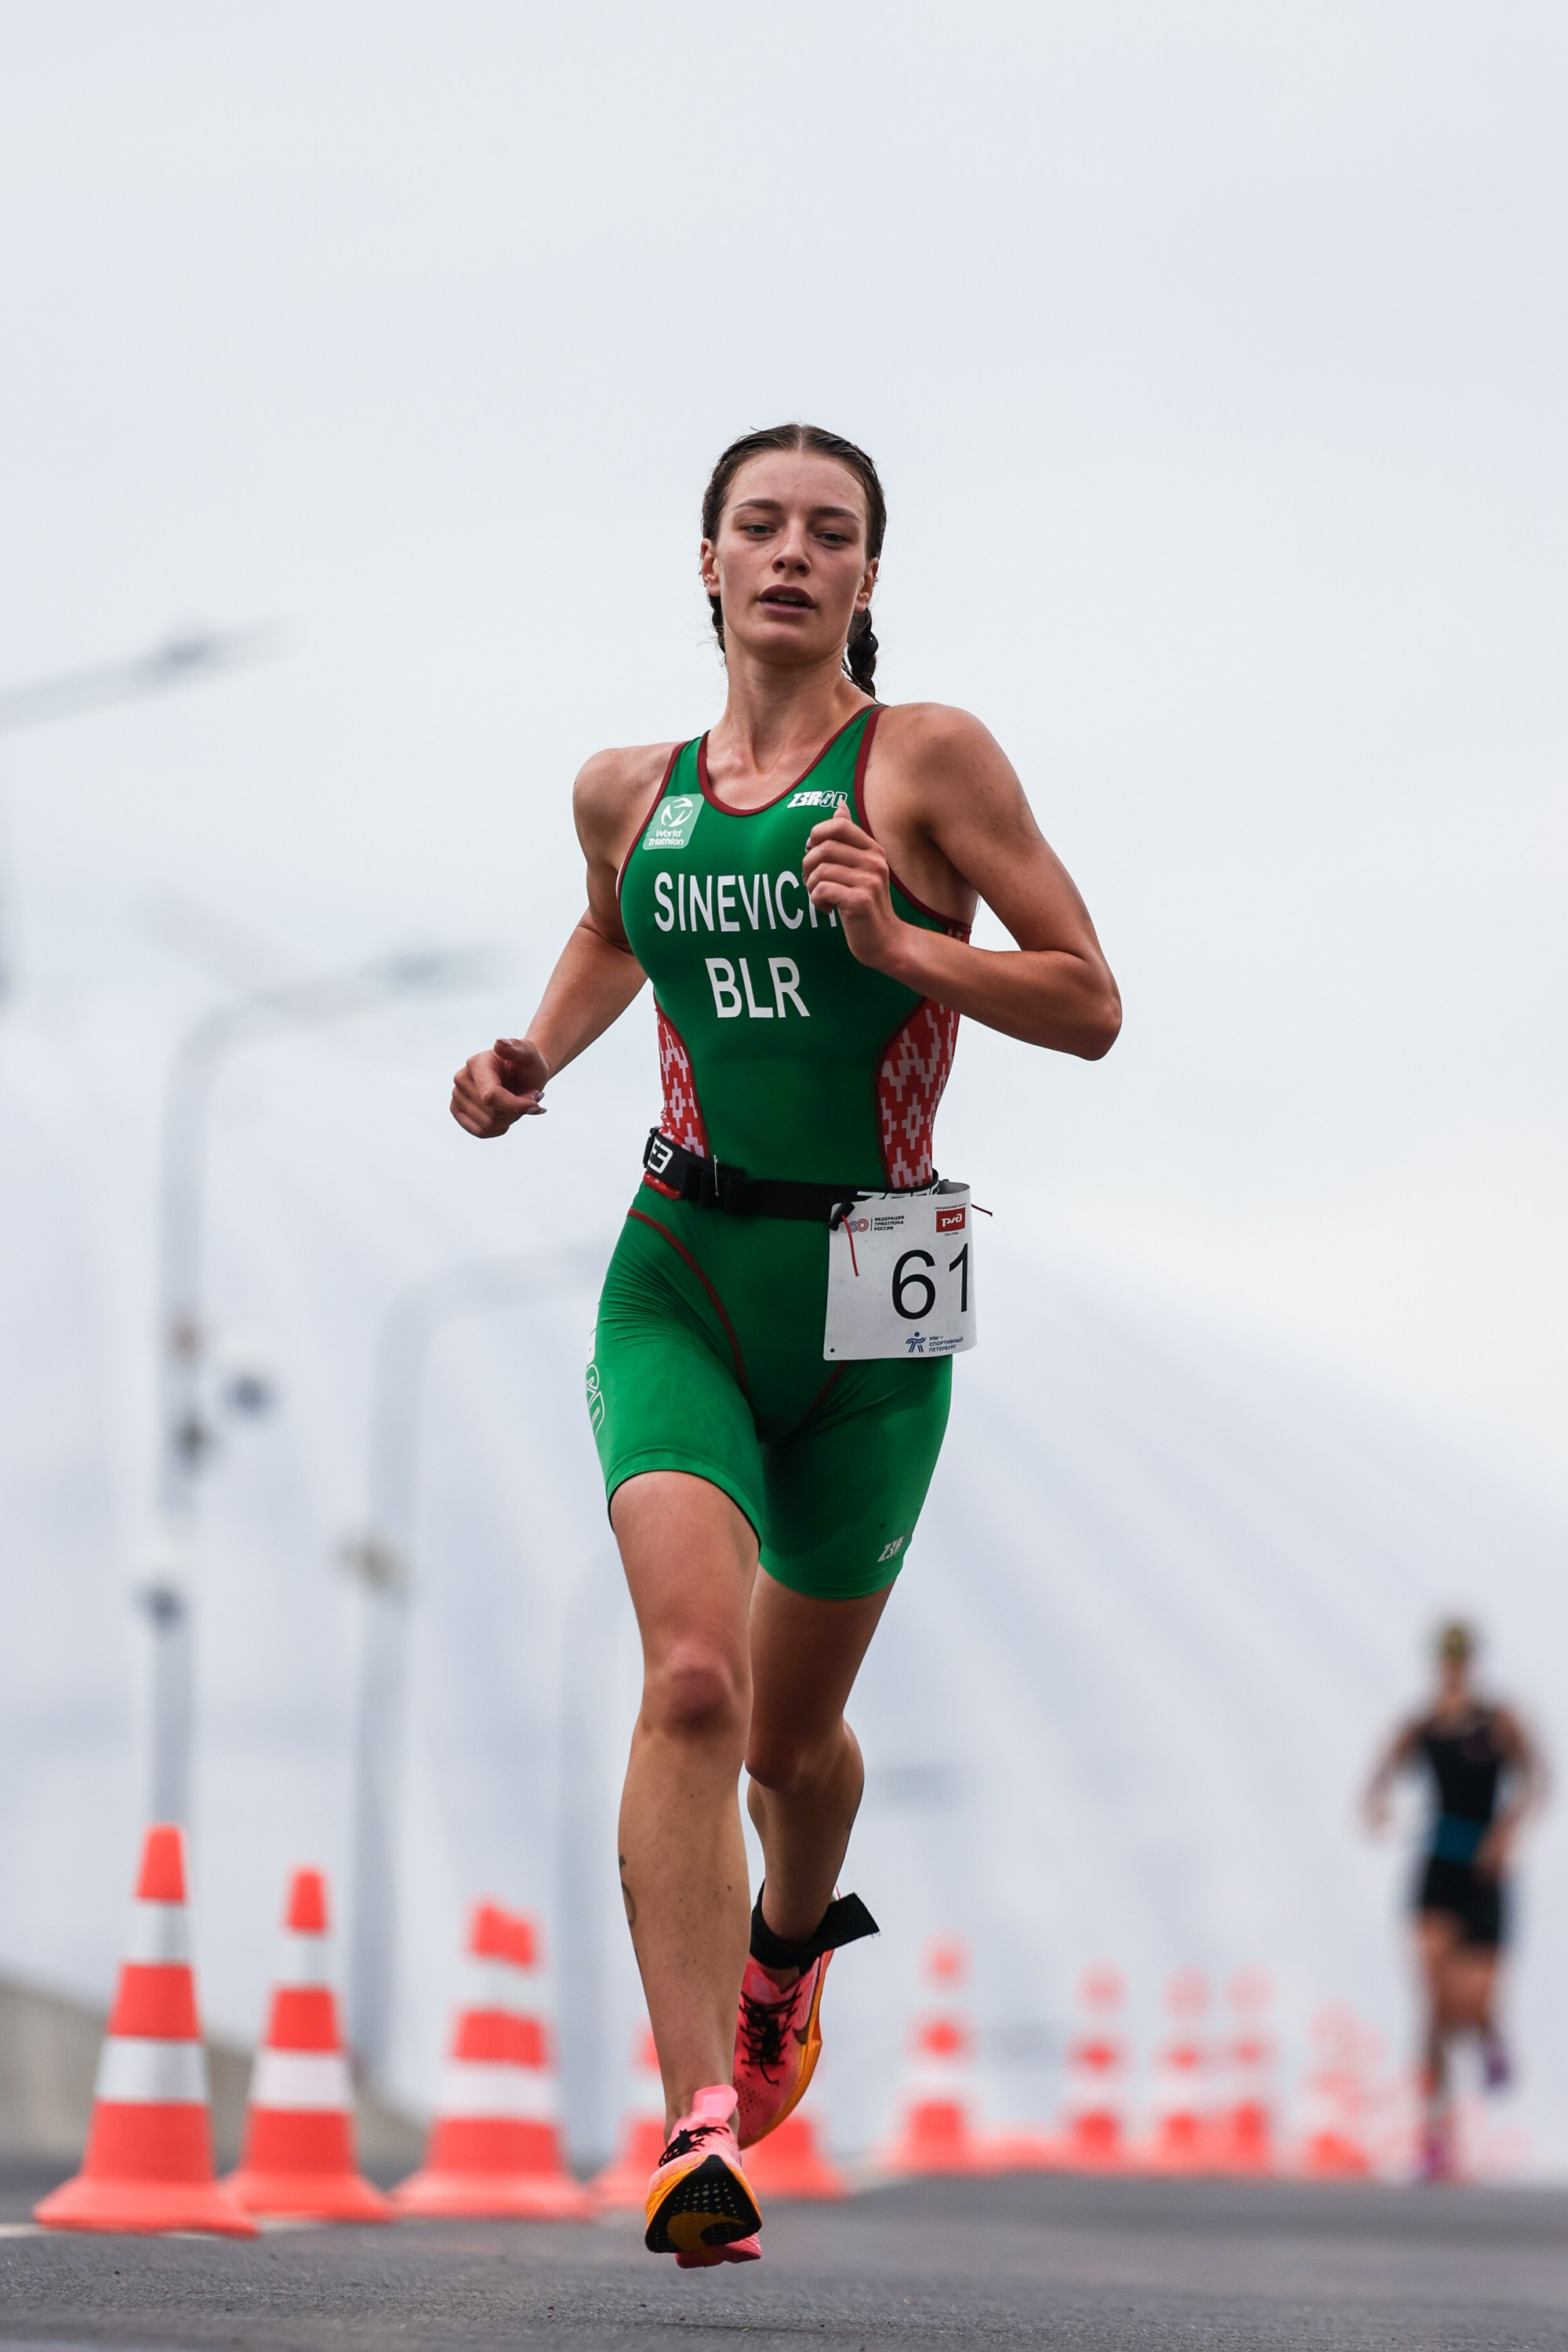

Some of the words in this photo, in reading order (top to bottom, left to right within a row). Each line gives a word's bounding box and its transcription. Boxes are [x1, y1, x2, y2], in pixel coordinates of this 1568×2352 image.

[655, 829, 682, 837] World
[648, 837, 684, 847] Triathlon
[705, 956, 811, 1018] BLR
[891, 1242, 969, 1320] 61
[928, 1336, 964, 1347] СПОРТИВНЫЙ
[928, 1344, 957, 1352] ПЕТЕРБУРГ
